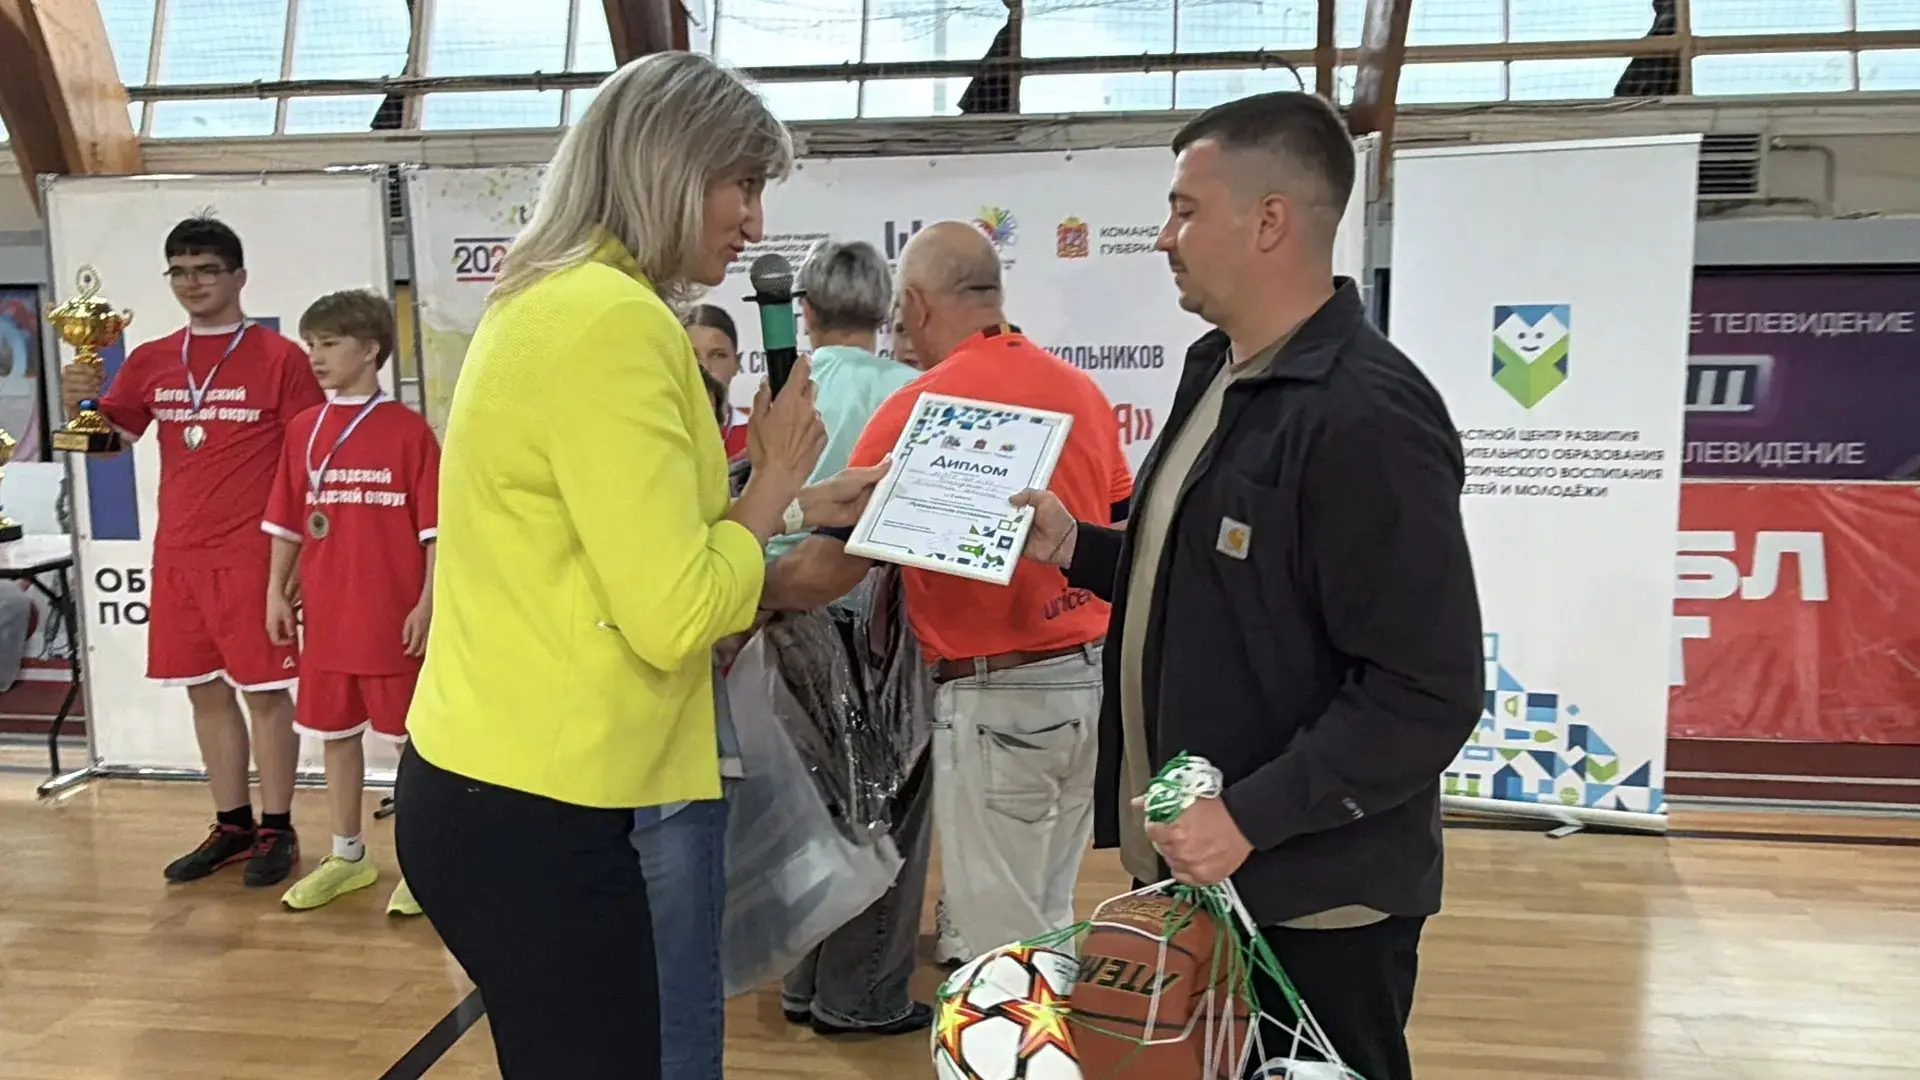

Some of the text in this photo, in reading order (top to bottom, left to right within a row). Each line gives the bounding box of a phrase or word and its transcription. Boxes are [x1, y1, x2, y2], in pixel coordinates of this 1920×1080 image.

[1710, 311, 1916, 337] ТЕЛЕВИДЕНИЕ
[1044, 344, 1165, 370] ОЛЬНИКОВ
[1519, 429, 1562, 442] ЦЕНТР
[1564, 430, 1640, 442] РАЗВИТИЯ
[1551, 448, 1664, 461] ОБРАЗОВАНИЯ
[1559, 466, 1664, 480] ВОСПИТАНИЯ
[1500, 484, 1513, 495] И
